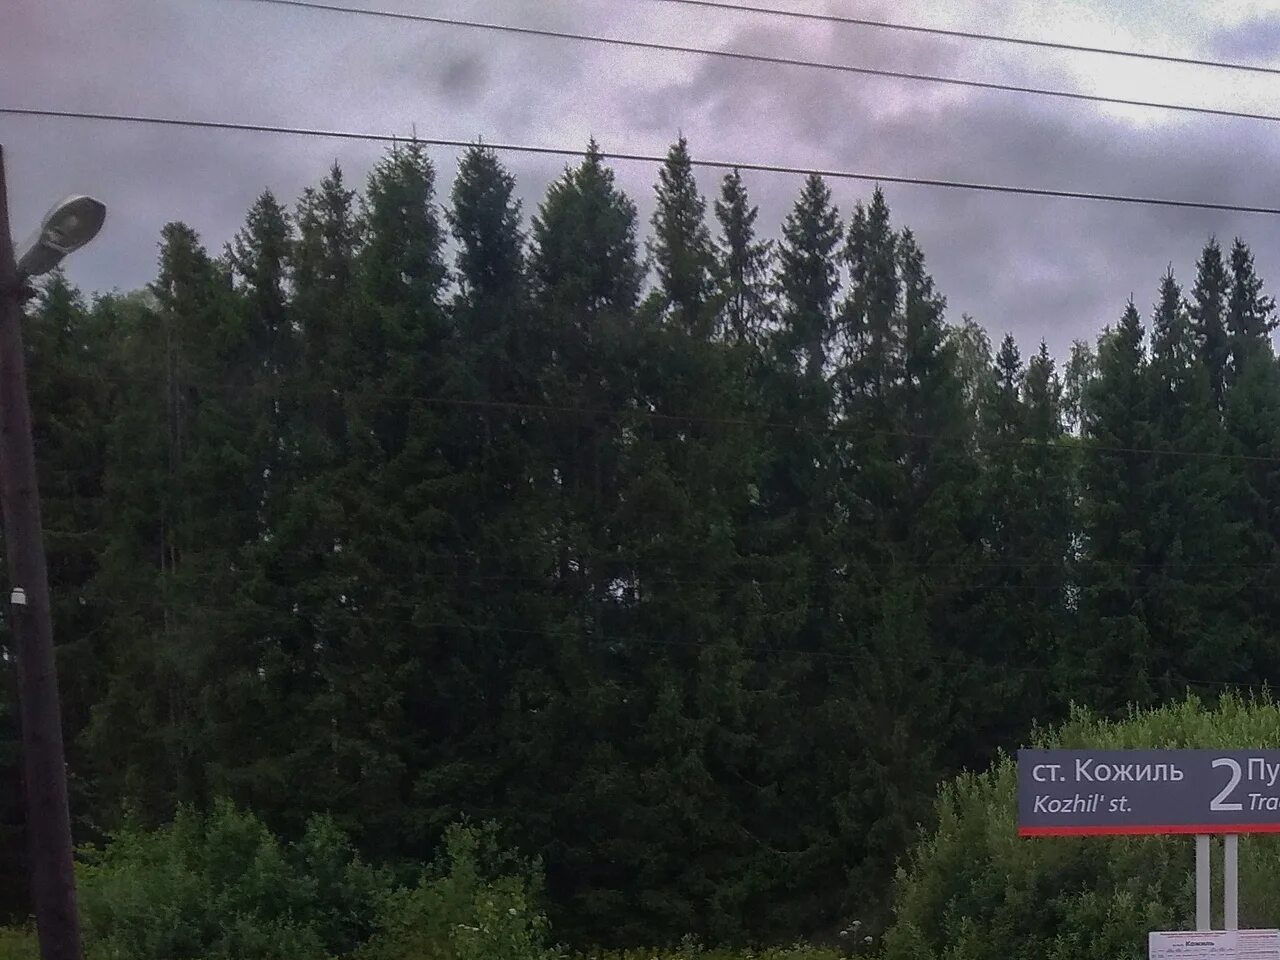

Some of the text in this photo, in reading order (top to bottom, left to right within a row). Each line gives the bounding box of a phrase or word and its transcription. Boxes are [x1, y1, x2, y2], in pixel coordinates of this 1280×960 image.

[1032, 758, 1184, 782] ст. Кожиль
[1209, 757, 1244, 811] 2
[1033, 793, 1132, 813] Kozhil' st.
